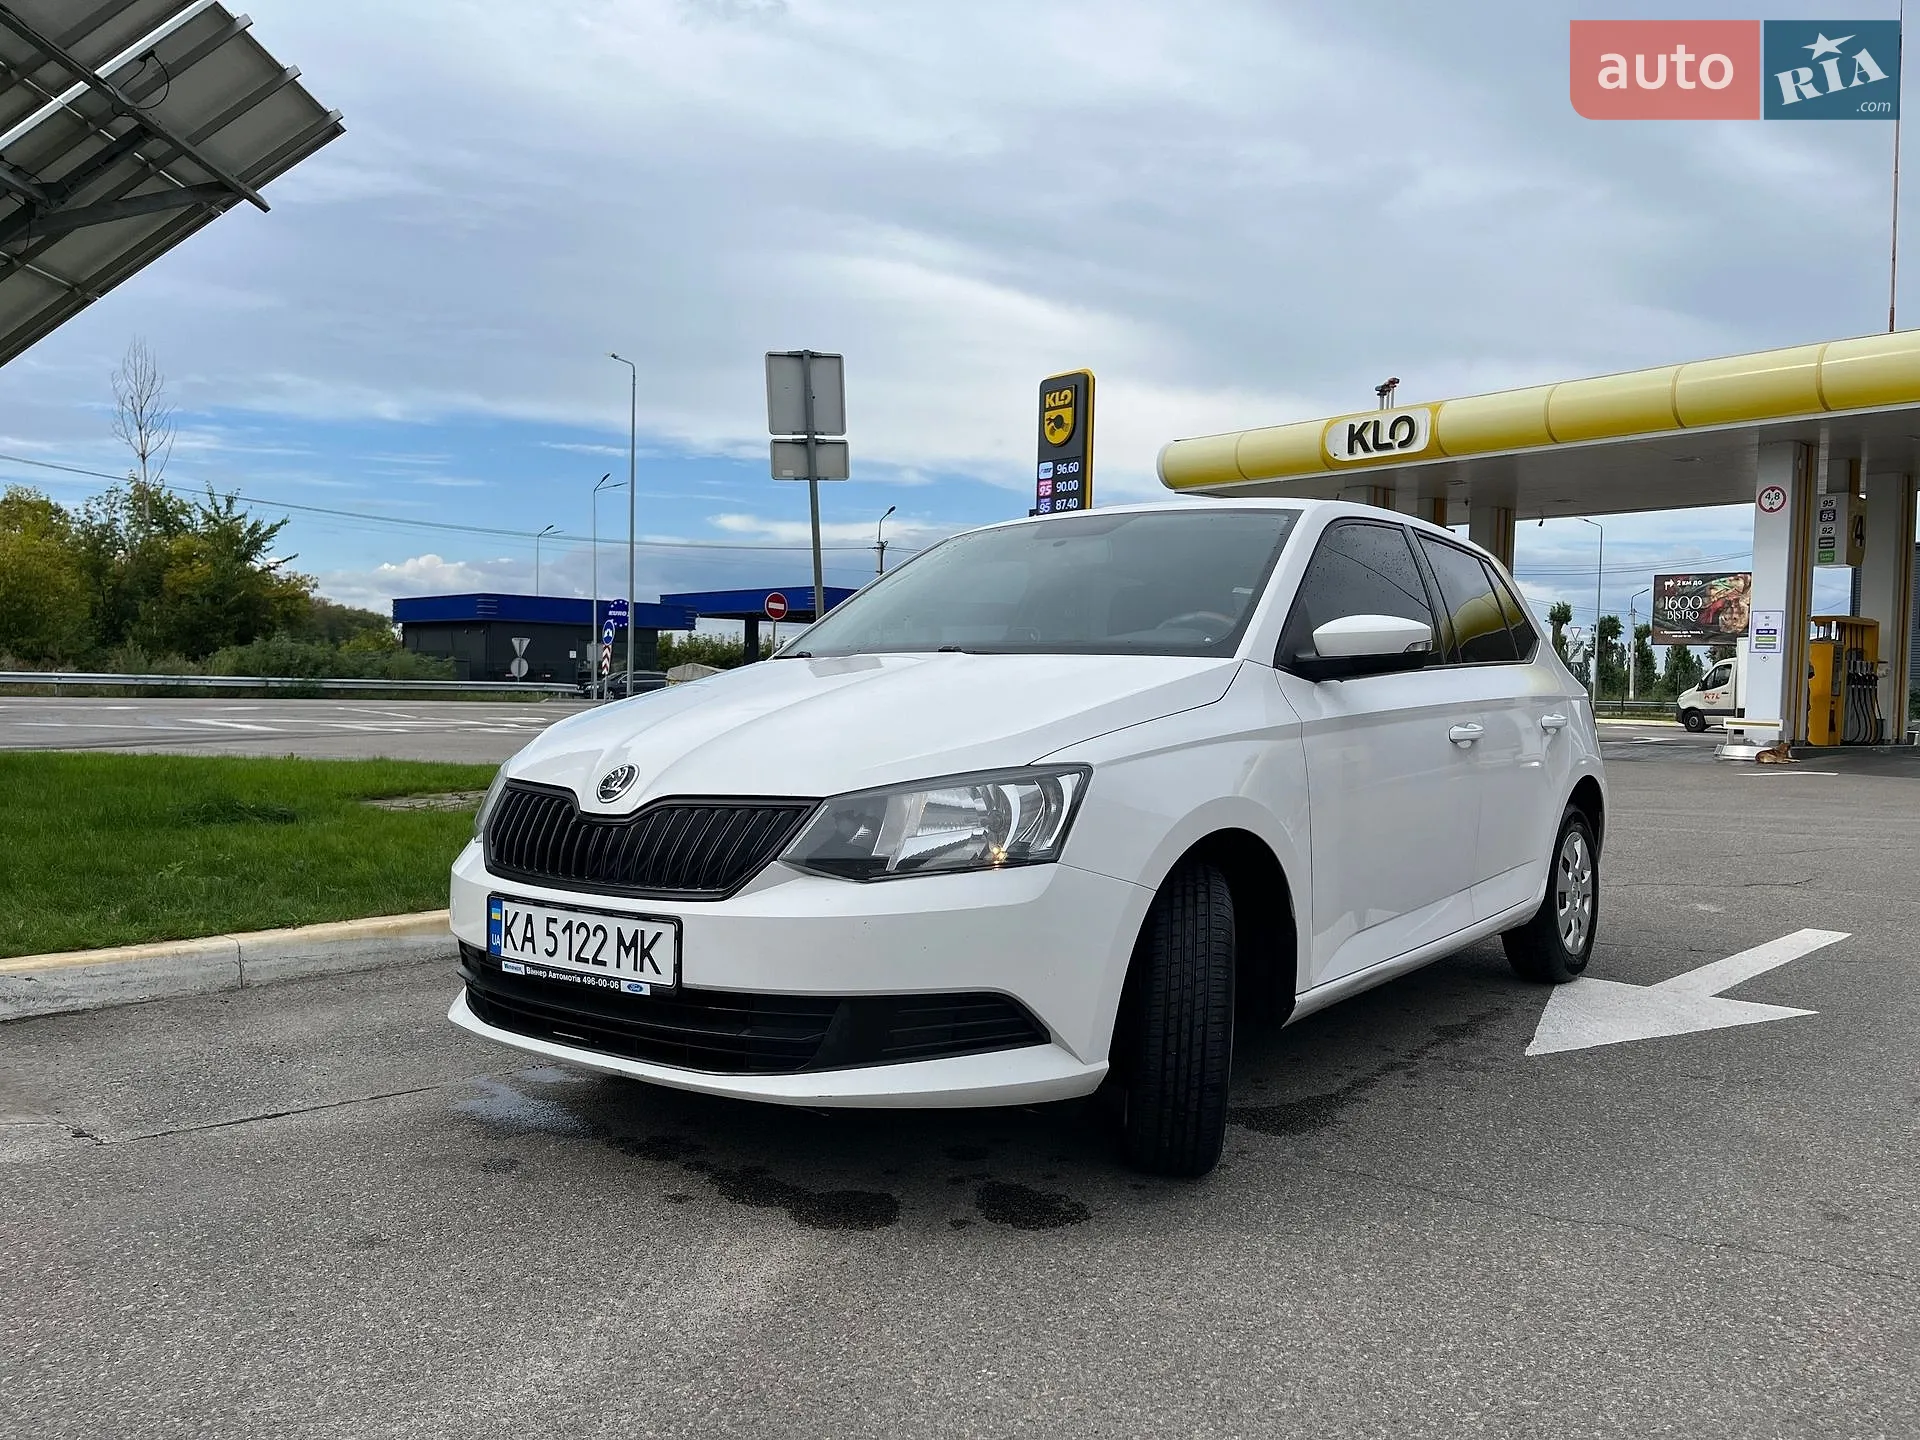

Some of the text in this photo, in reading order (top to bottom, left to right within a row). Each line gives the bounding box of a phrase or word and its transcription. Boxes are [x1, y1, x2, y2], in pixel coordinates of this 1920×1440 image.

[1045, 389, 1072, 409] KLO
[1347, 415, 1416, 456] KLO
[1056, 461, 1079, 475] 96.60
[1039, 485, 1052, 496] 95
[1056, 480, 1079, 493] 90.00
[1765, 492, 1780, 502] 4,8
[1822, 499, 1834, 508] 95
[1039, 503, 1051, 513] 95
[1055, 498, 1078, 511] 87.40
[1822, 513, 1834, 521] 95
[1821, 526, 1834, 534] 92
[1855, 515, 1865, 547] 4
[1664, 595, 1703, 610] 1600
[1667, 608, 1699, 622] BISTRO
[491, 933, 501, 946] UA
[504, 909, 663, 975] KA 5122 MK
[582, 976, 620, 990] 496-00-06
